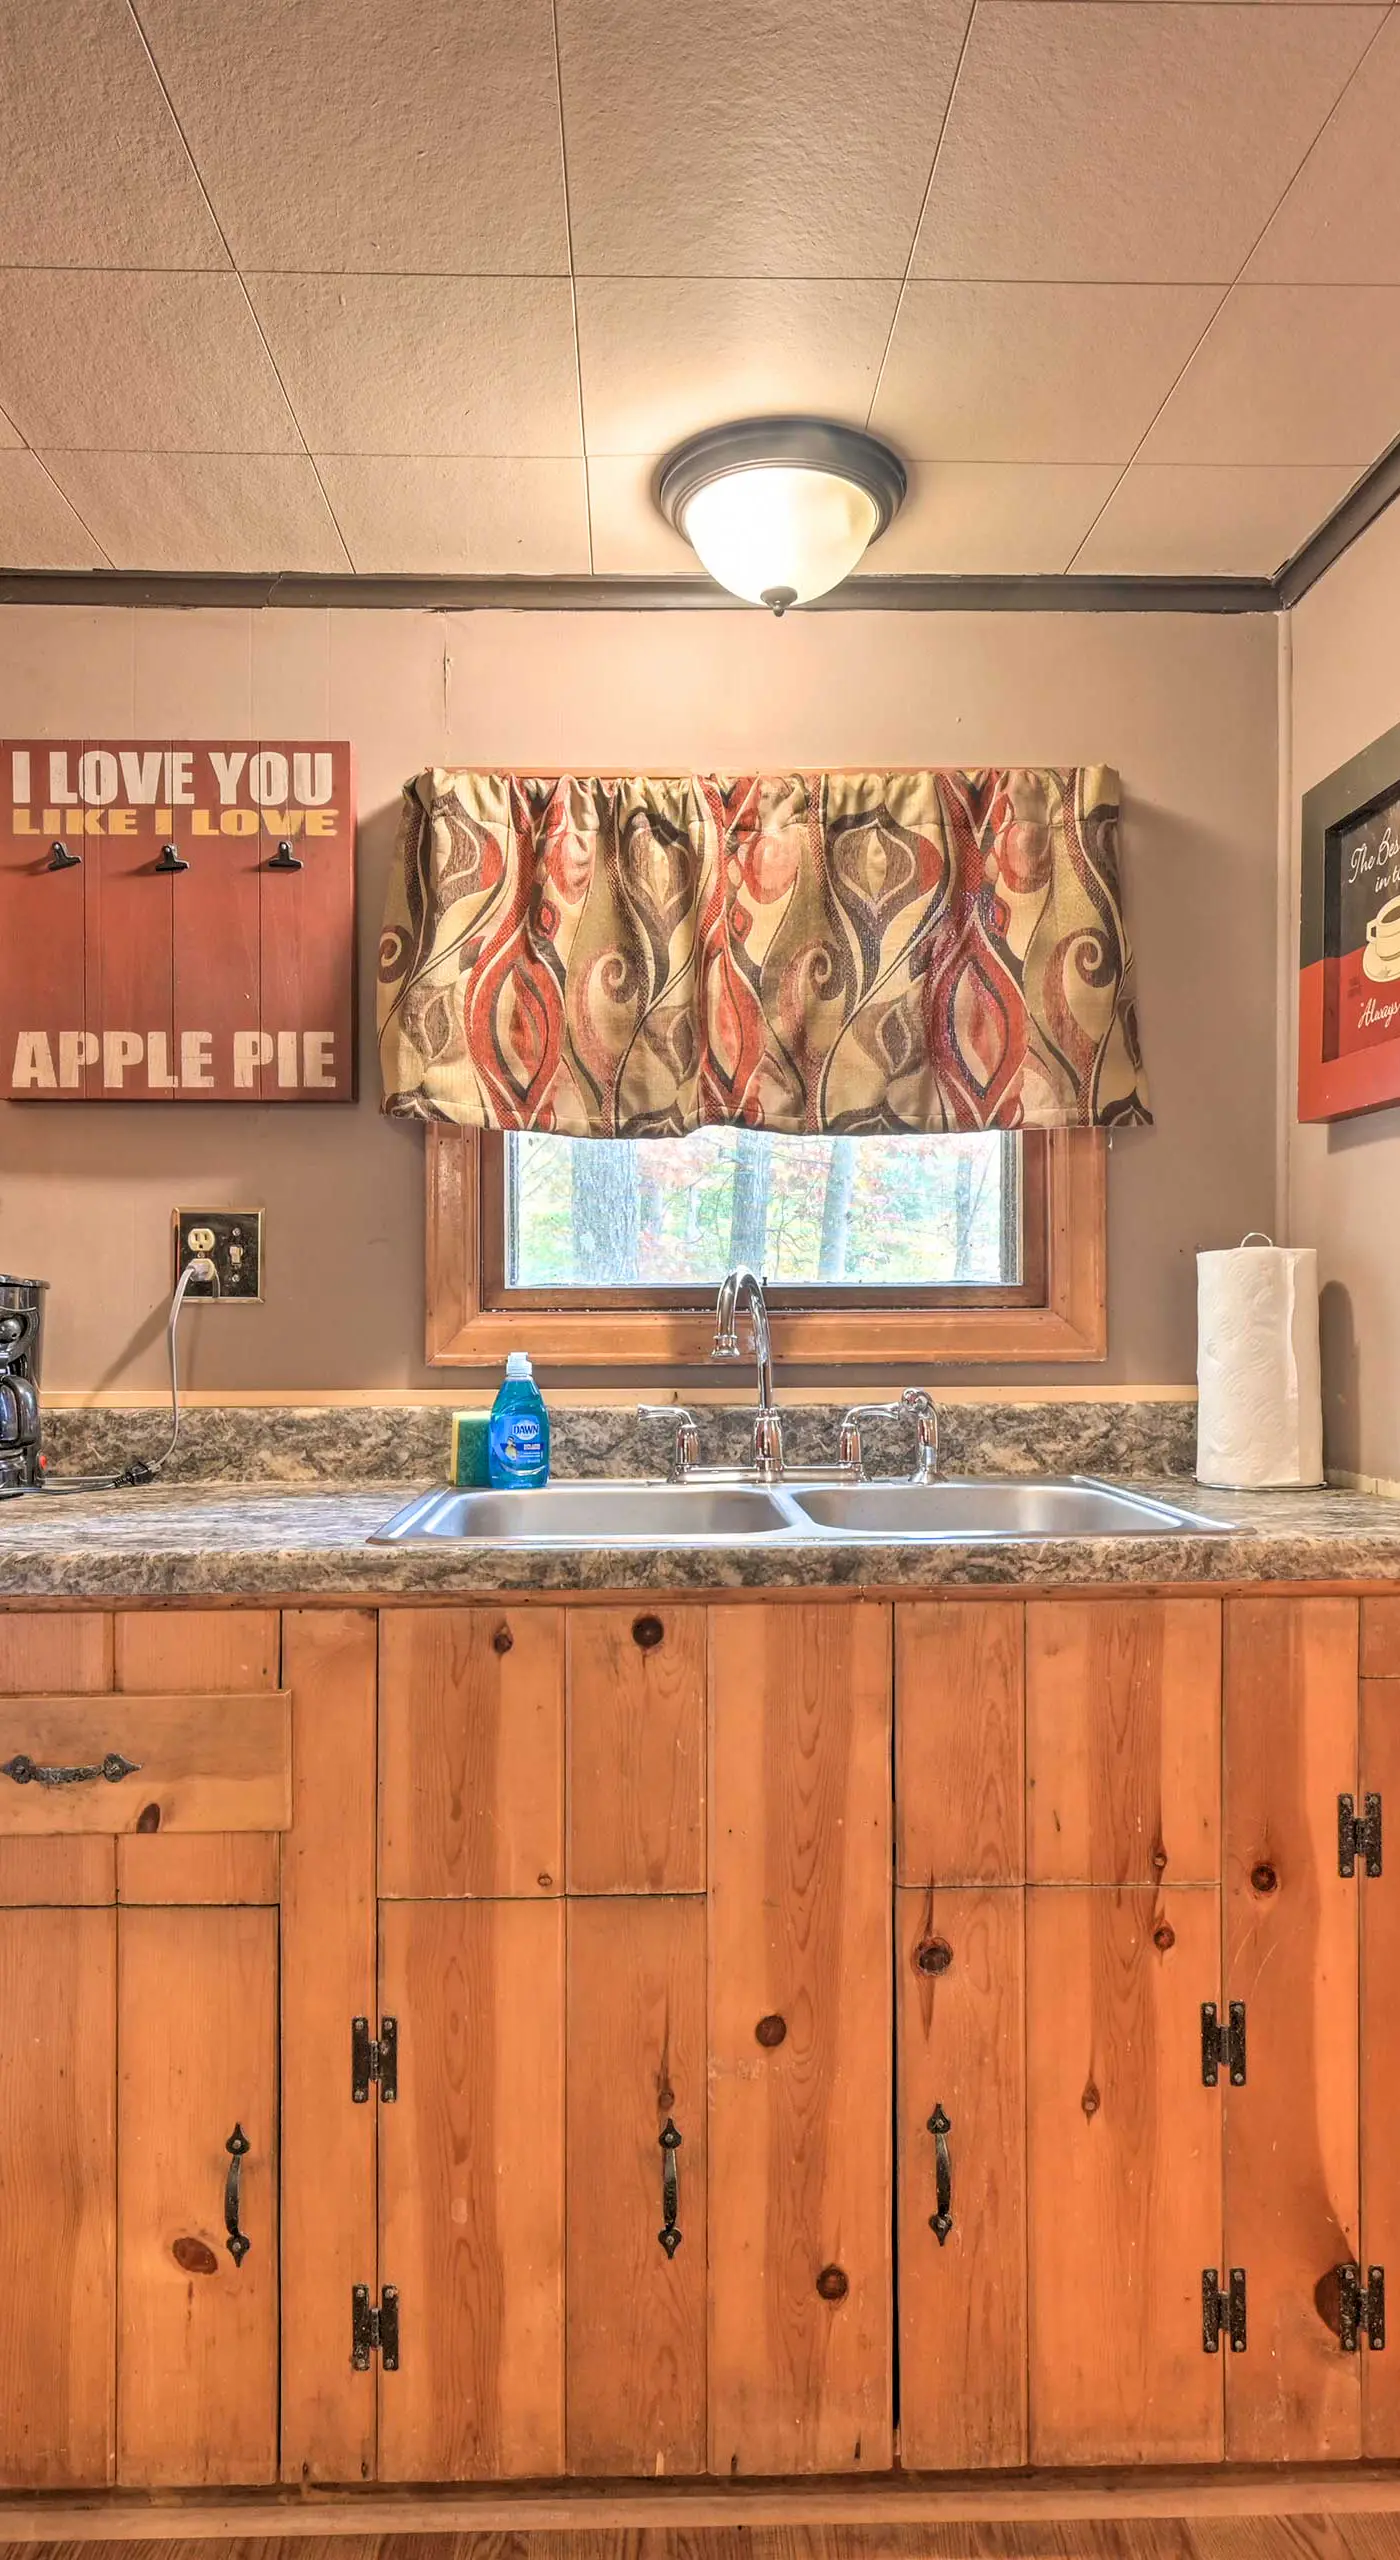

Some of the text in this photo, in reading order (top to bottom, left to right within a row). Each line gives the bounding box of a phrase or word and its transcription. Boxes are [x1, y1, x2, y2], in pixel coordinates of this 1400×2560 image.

[12, 750, 333, 806] I LOVE YOU
[13, 809, 339, 836] LIKE I LOVE
[1348, 827, 1400, 884] The Bes
[1375, 876, 1392, 893] in
[11, 1031, 337, 1088] APPLE PIE
[513, 1425, 539, 1435] DAWN
